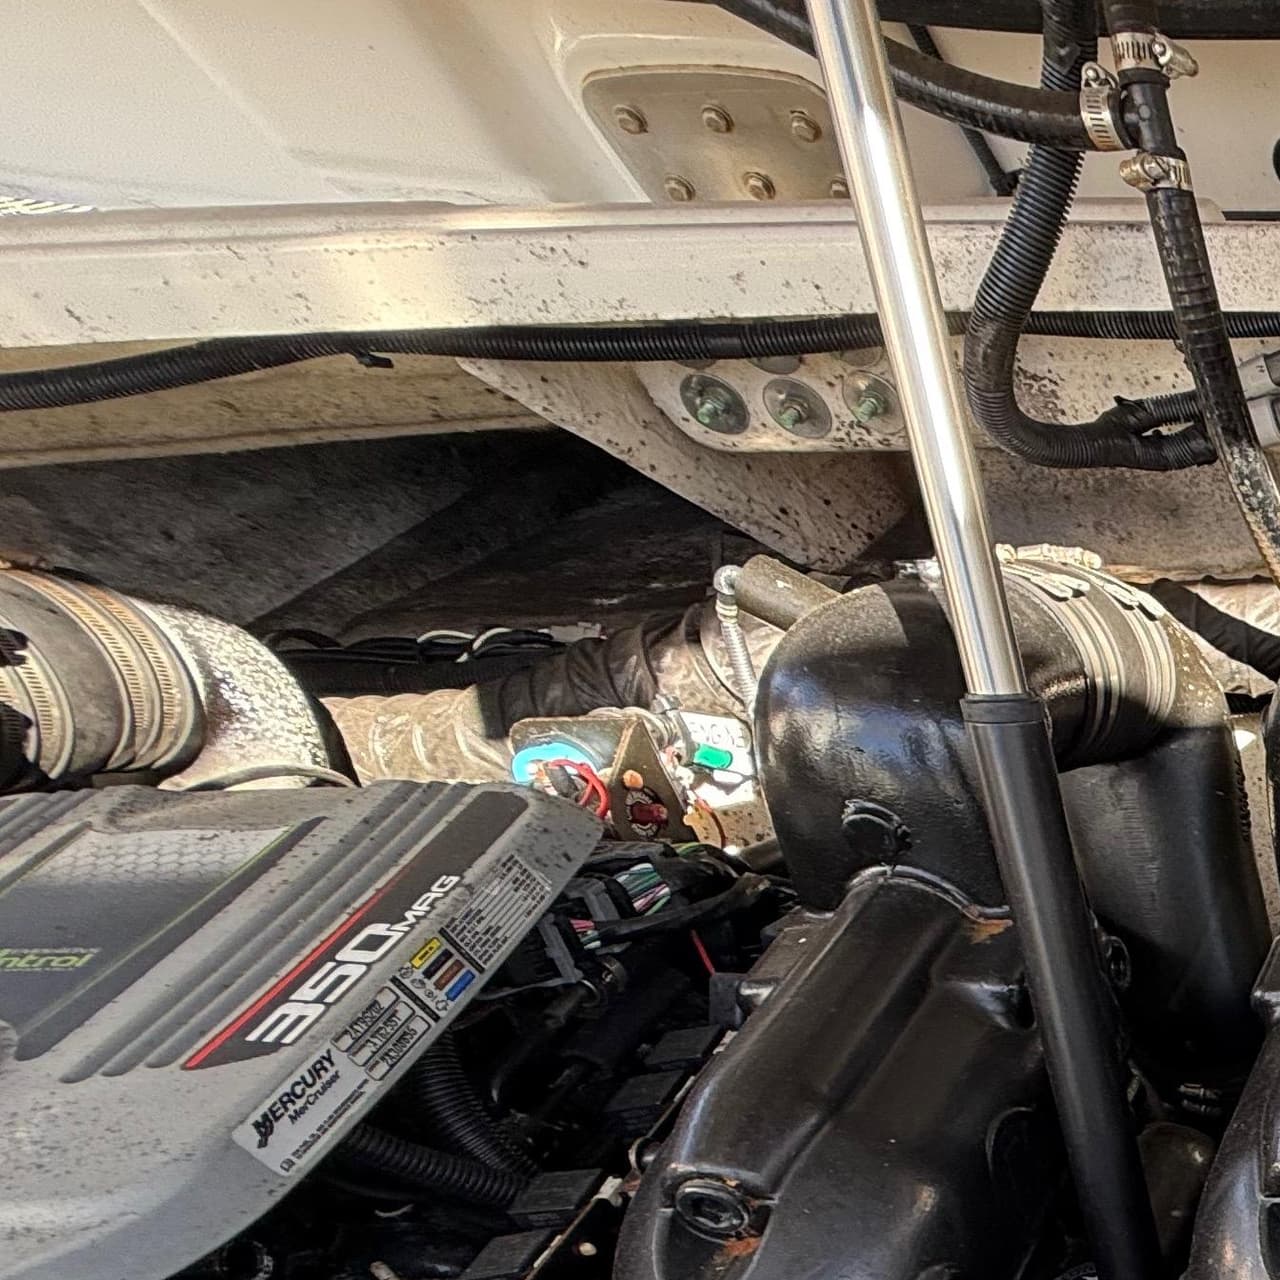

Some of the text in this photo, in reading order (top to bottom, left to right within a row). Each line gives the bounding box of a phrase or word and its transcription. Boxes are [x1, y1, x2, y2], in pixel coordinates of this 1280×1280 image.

[245, 923, 403, 1044] 350
[391, 875, 461, 932] MAG
[251, 1049, 336, 1148] MERCURY
[288, 1070, 341, 1125] MerCruiser
